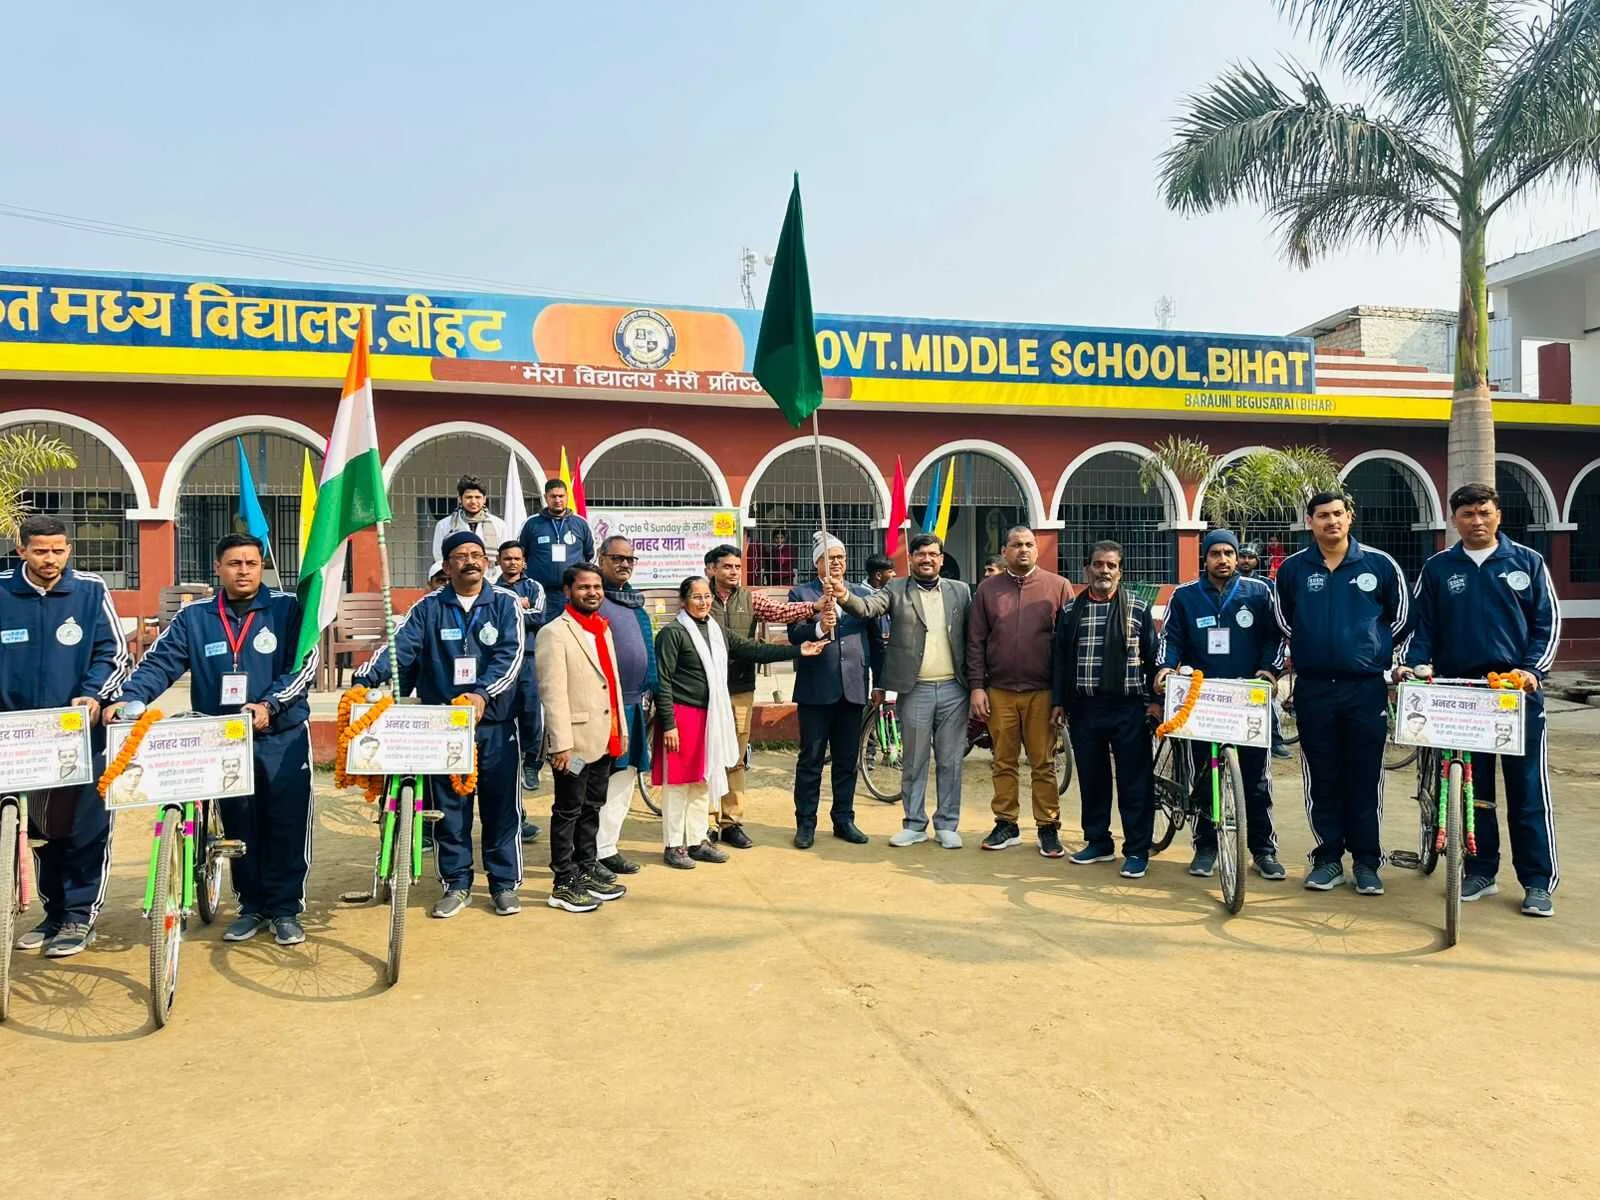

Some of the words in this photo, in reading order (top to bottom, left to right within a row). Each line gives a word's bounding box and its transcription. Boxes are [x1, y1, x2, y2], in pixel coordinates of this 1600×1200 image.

[50, 286, 176, 337] मध्य
[385, 293, 507, 358] बीहट
[815, 329, 898, 371] OVT.
[901, 333, 1040, 376] MIDDLE
[1207, 346, 1310, 386] BIHAT
[574, 364, 657, 389] विद्यालय
[706, 371, 764, 393] प्रतिष्ठ
[1184, 392, 1232, 409] BARAUNI
[618, 522, 642, 535] Cycle
[650, 521, 682, 535] Sunday
[629, 537, 660, 552] नहद
[661, 537, 685, 552] यात्रा
